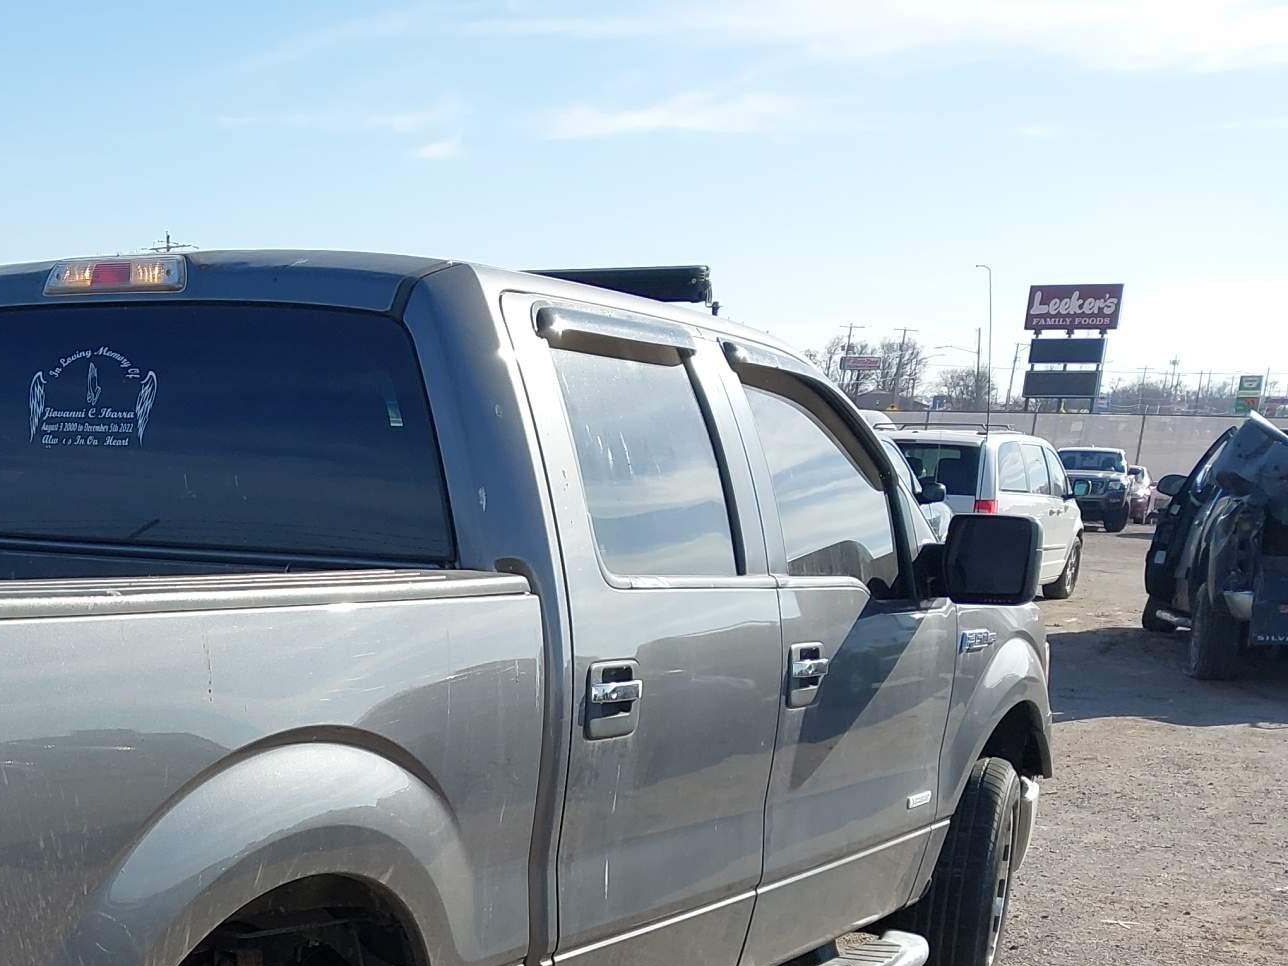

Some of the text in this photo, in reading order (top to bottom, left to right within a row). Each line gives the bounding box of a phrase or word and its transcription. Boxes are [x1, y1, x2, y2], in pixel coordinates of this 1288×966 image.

[1030, 290, 1118, 315] Leeker's
[1075, 317, 1111, 325] FOODS
[48, 367, 62, 377] In
[60, 349, 92, 367] Loving
[94, 346, 131, 368] Memory
[88, 407, 97, 418] C
[98, 407, 135, 418] Ibarra
[41, 422, 58, 433] August
[84, 422, 109, 433] December
[119, 423, 134, 433] 2022
[104, 435, 129, 446] Heart
